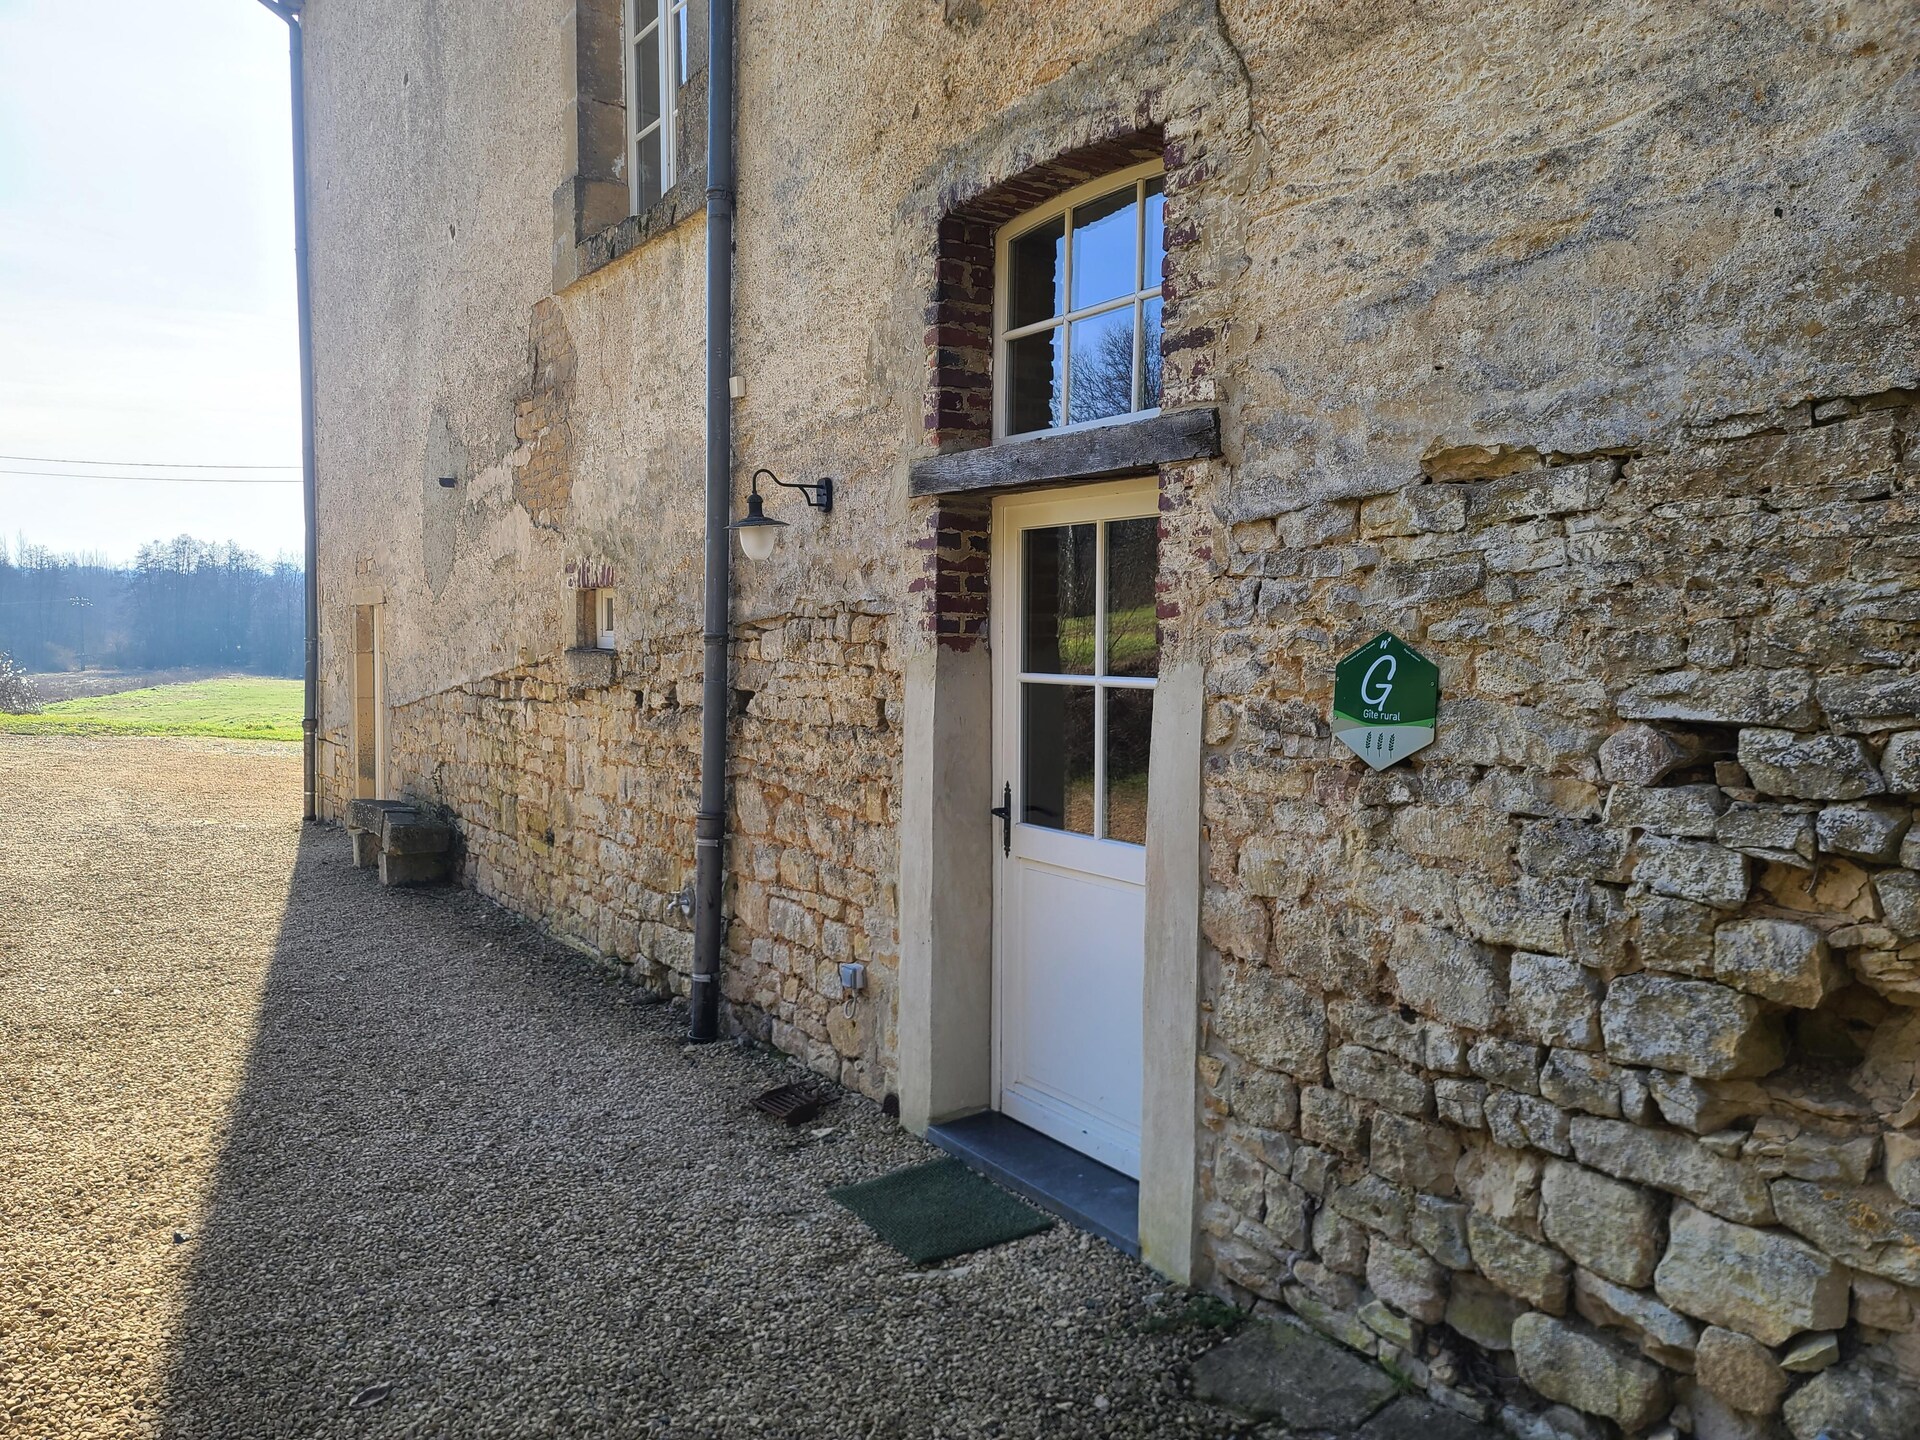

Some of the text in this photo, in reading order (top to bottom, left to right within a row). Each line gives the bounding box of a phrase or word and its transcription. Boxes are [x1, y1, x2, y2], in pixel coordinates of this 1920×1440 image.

[1361, 655, 1396, 711] G
[1363, 709, 1401, 721] Gîte rural
